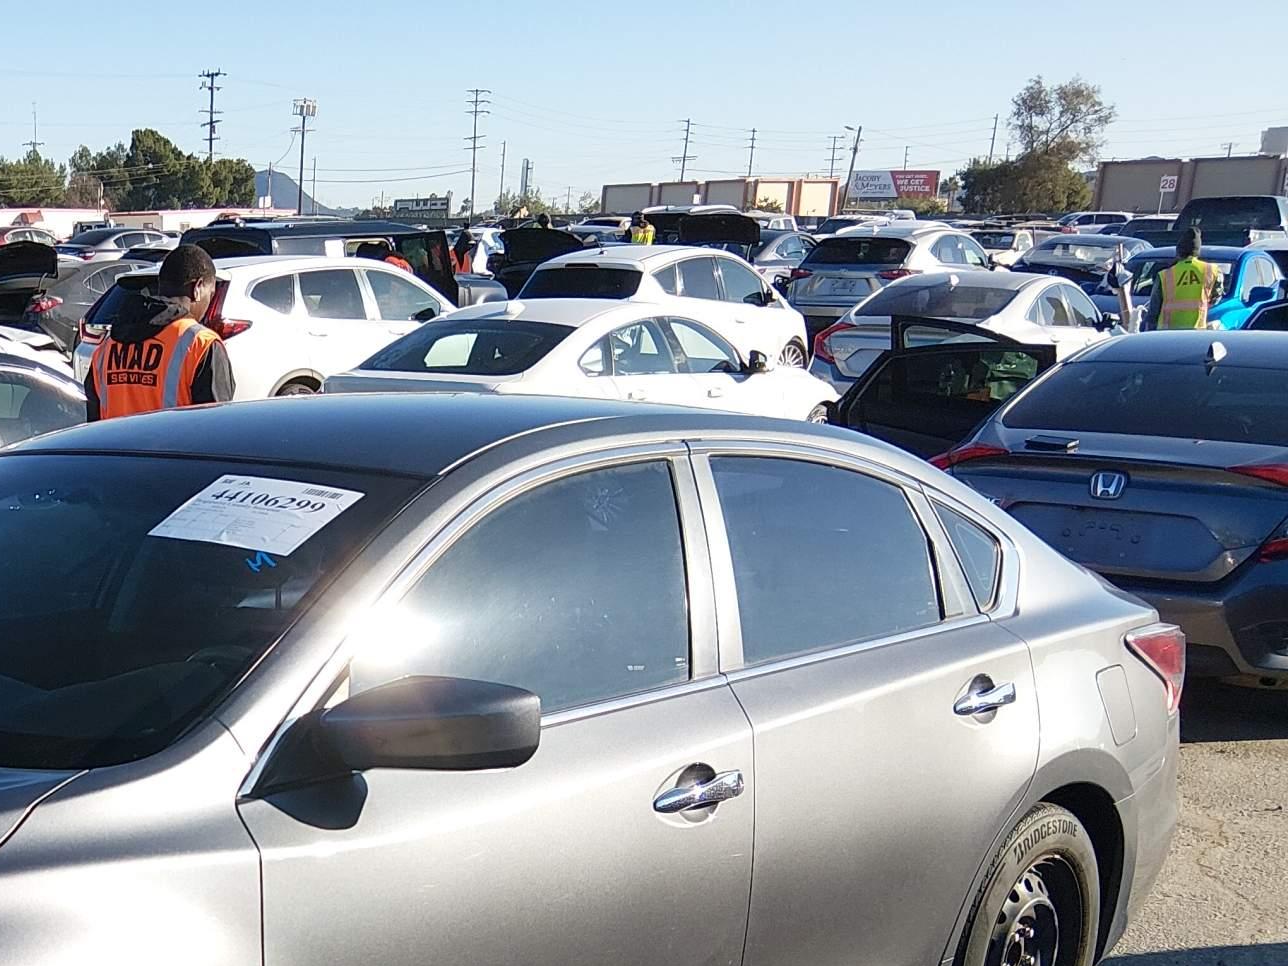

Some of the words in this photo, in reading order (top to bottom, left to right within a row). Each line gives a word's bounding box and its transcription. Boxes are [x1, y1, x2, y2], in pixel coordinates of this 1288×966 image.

[1160, 178, 1176, 189] 28
[110, 373, 154, 385] SERVIES
[211, 488, 327, 514] 44106299
[1013, 817, 1078, 866] BRIDGESTONE
